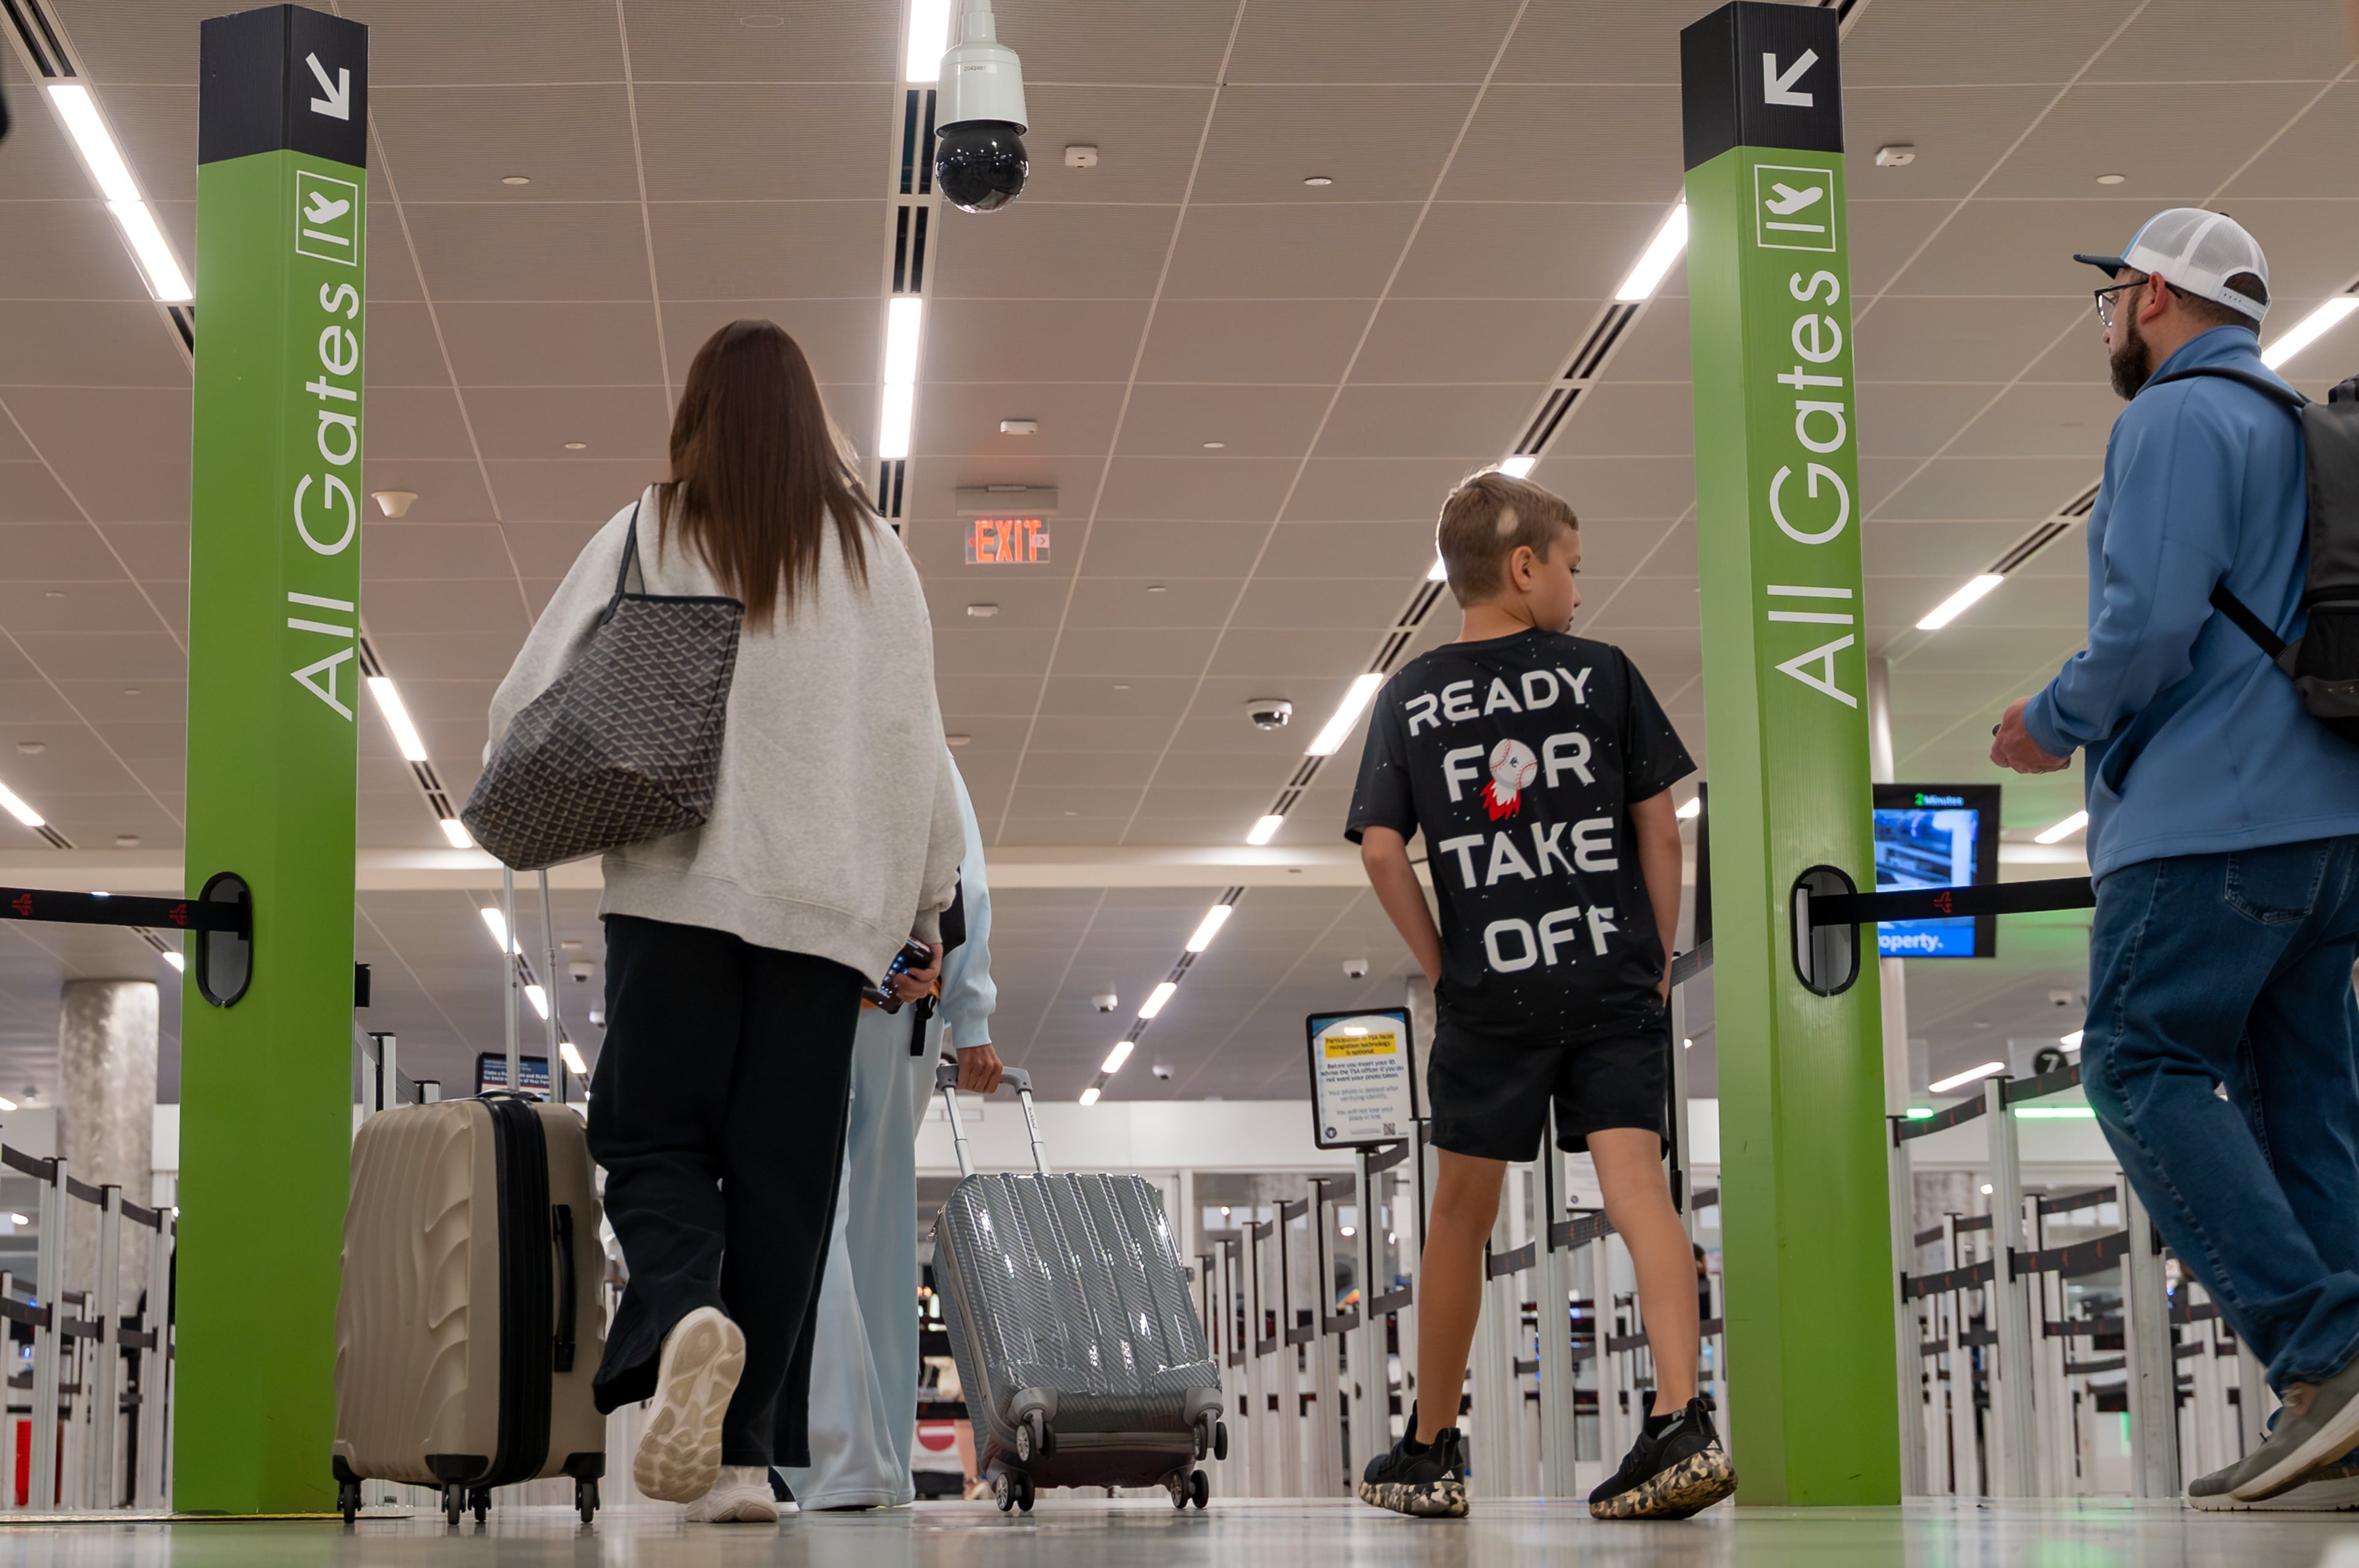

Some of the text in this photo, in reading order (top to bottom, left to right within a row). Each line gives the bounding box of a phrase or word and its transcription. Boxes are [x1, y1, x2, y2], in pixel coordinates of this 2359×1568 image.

[288, 283, 359, 722] All Gates
[1768, 271, 1857, 709] All Gates
[975, 519, 1042, 562] EXIT
[1405, 667, 1592, 736] READY
[1914, 793, 1964, 806] 2 Minutes
[1439, 817, 1619, 889] TAKE
[1484, 905, 1619, 973] OFF
[2041, 1053, 2059, 1073] 7
